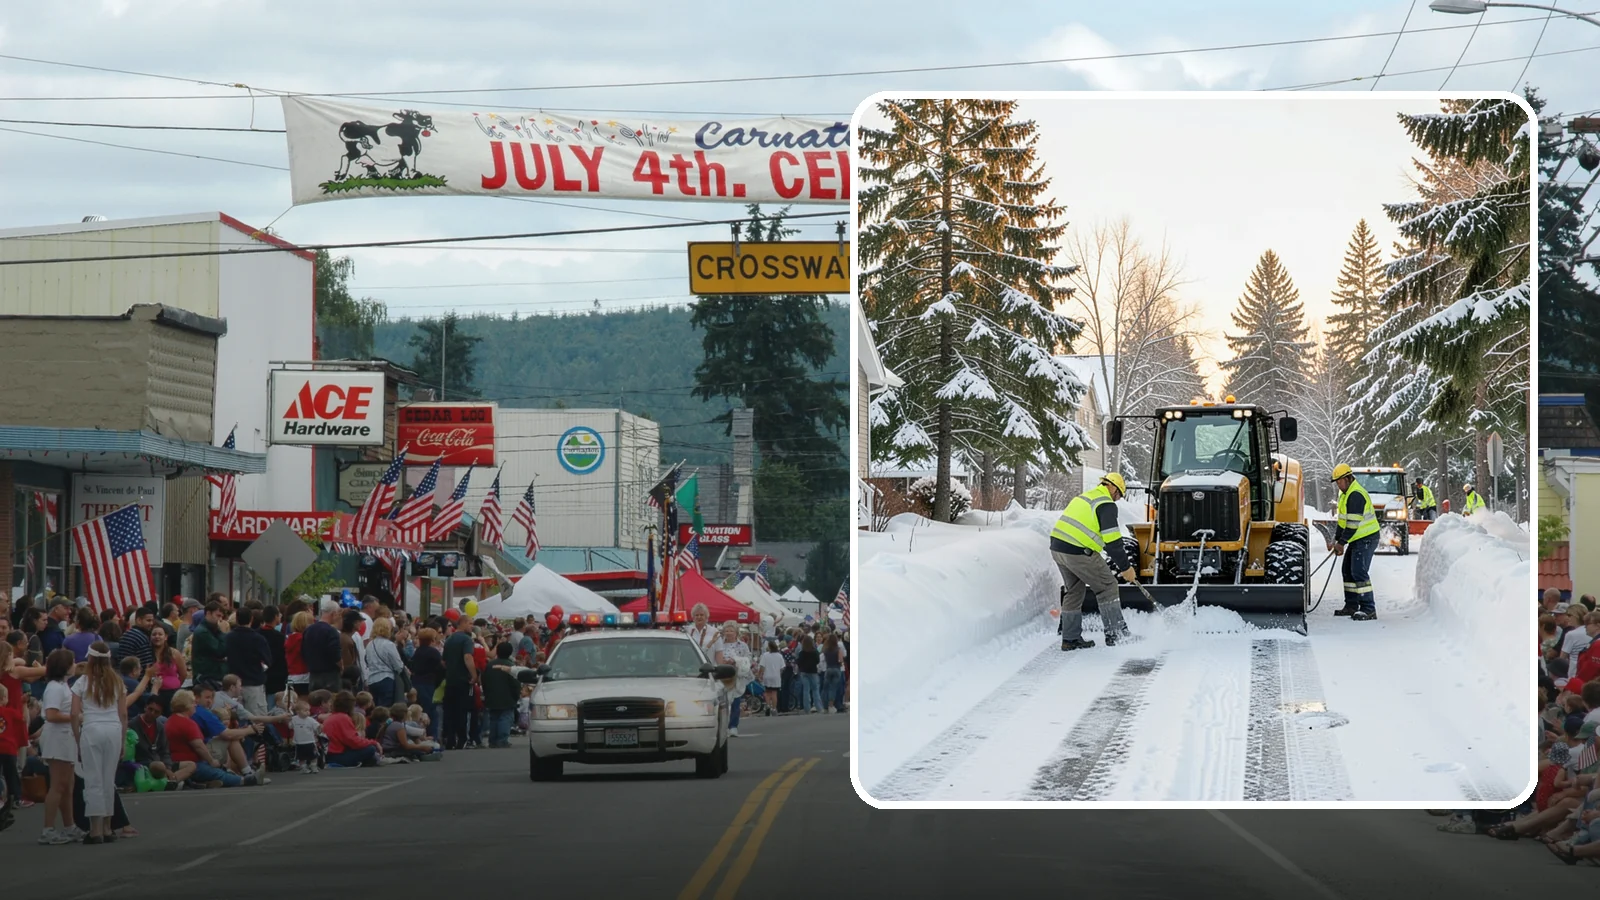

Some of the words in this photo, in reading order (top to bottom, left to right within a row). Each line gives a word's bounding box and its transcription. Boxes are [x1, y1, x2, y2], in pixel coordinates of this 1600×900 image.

[695, 121, 850, 149] Carnat
[481, 141, 605, 192] JULY
[632, 150, 746, 197] 4th.
[696, 254, 850, 280] CROSSWA
[283, 380, 373, 420] ACE
[405, 409, 453, 422] CEDAR
[283, 421, 371, 437] Hardware
[416, 428, 477, 447] Coca-Cola
[83, 484, 93, 494] St.
[96, 485, 124, 494] Vincent
[126, 486, 135, 494] de
[137, 486, 155, 495] Paul
[688, 526, 742, 535] CRNATION
[699, 535, 730, 543] GLASS
